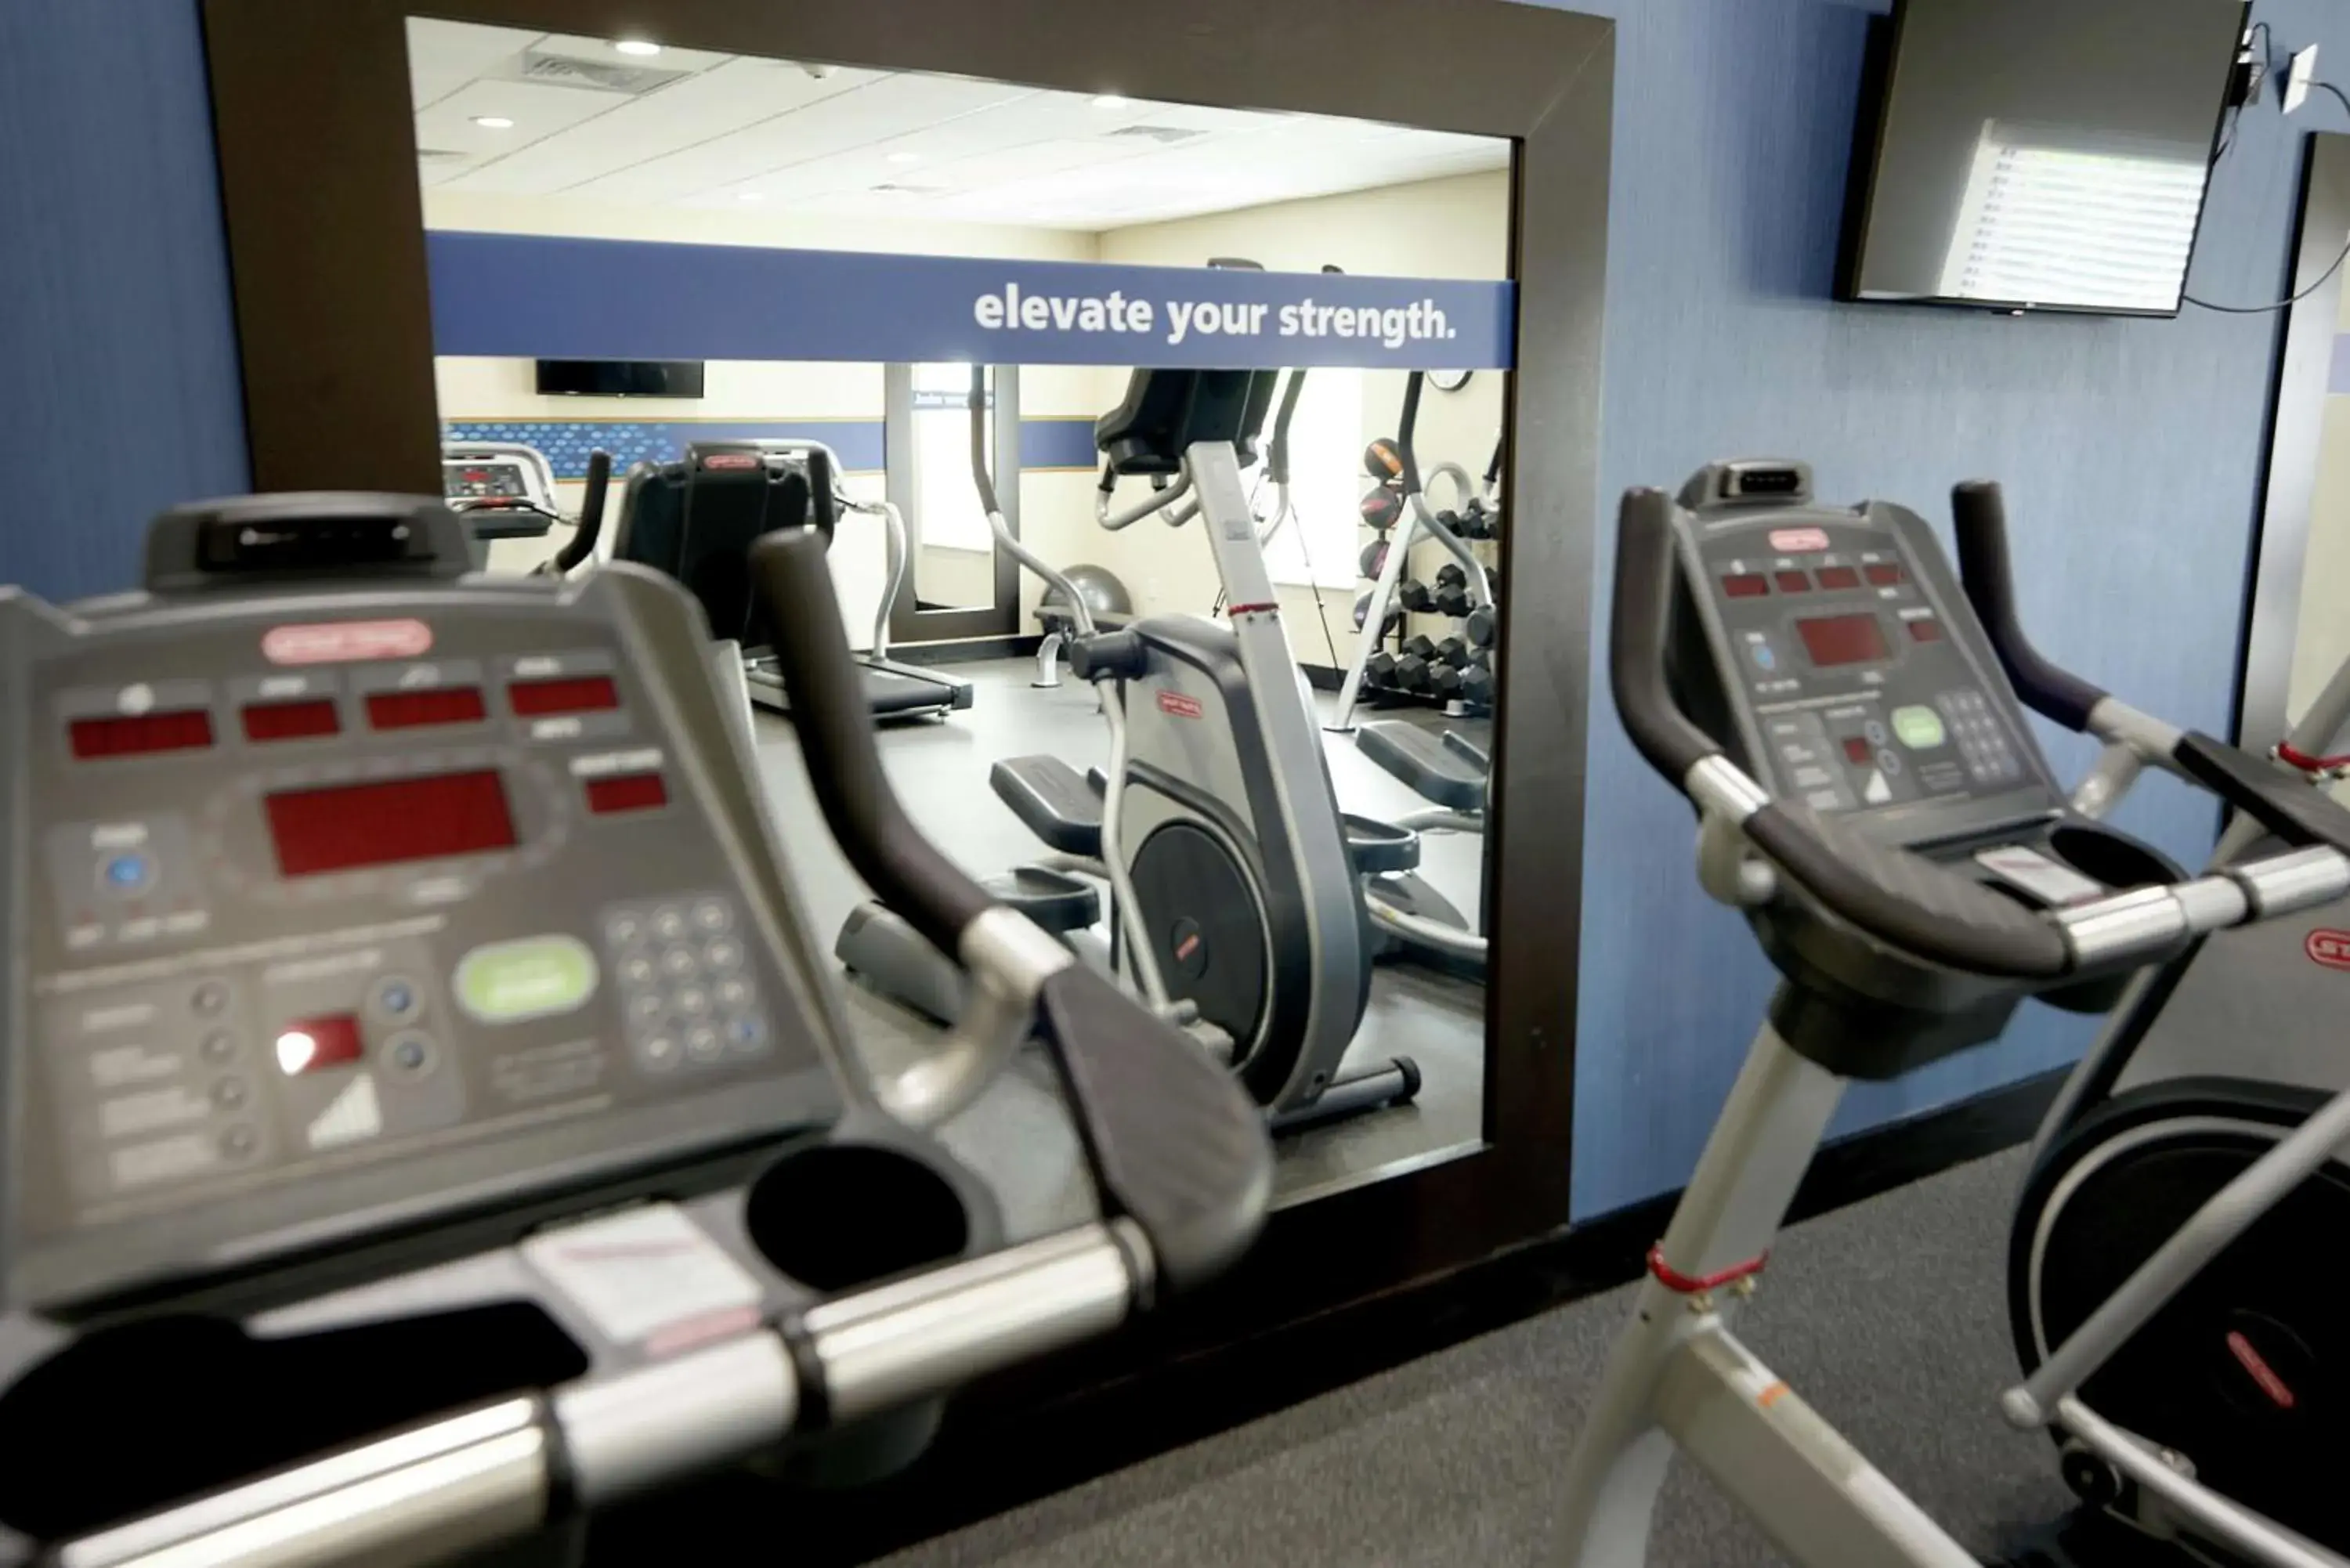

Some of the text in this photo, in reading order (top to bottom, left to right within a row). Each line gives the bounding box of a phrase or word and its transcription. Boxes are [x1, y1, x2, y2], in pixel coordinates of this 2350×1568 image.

[974, 282, 1458, 349] elevate your strength.
